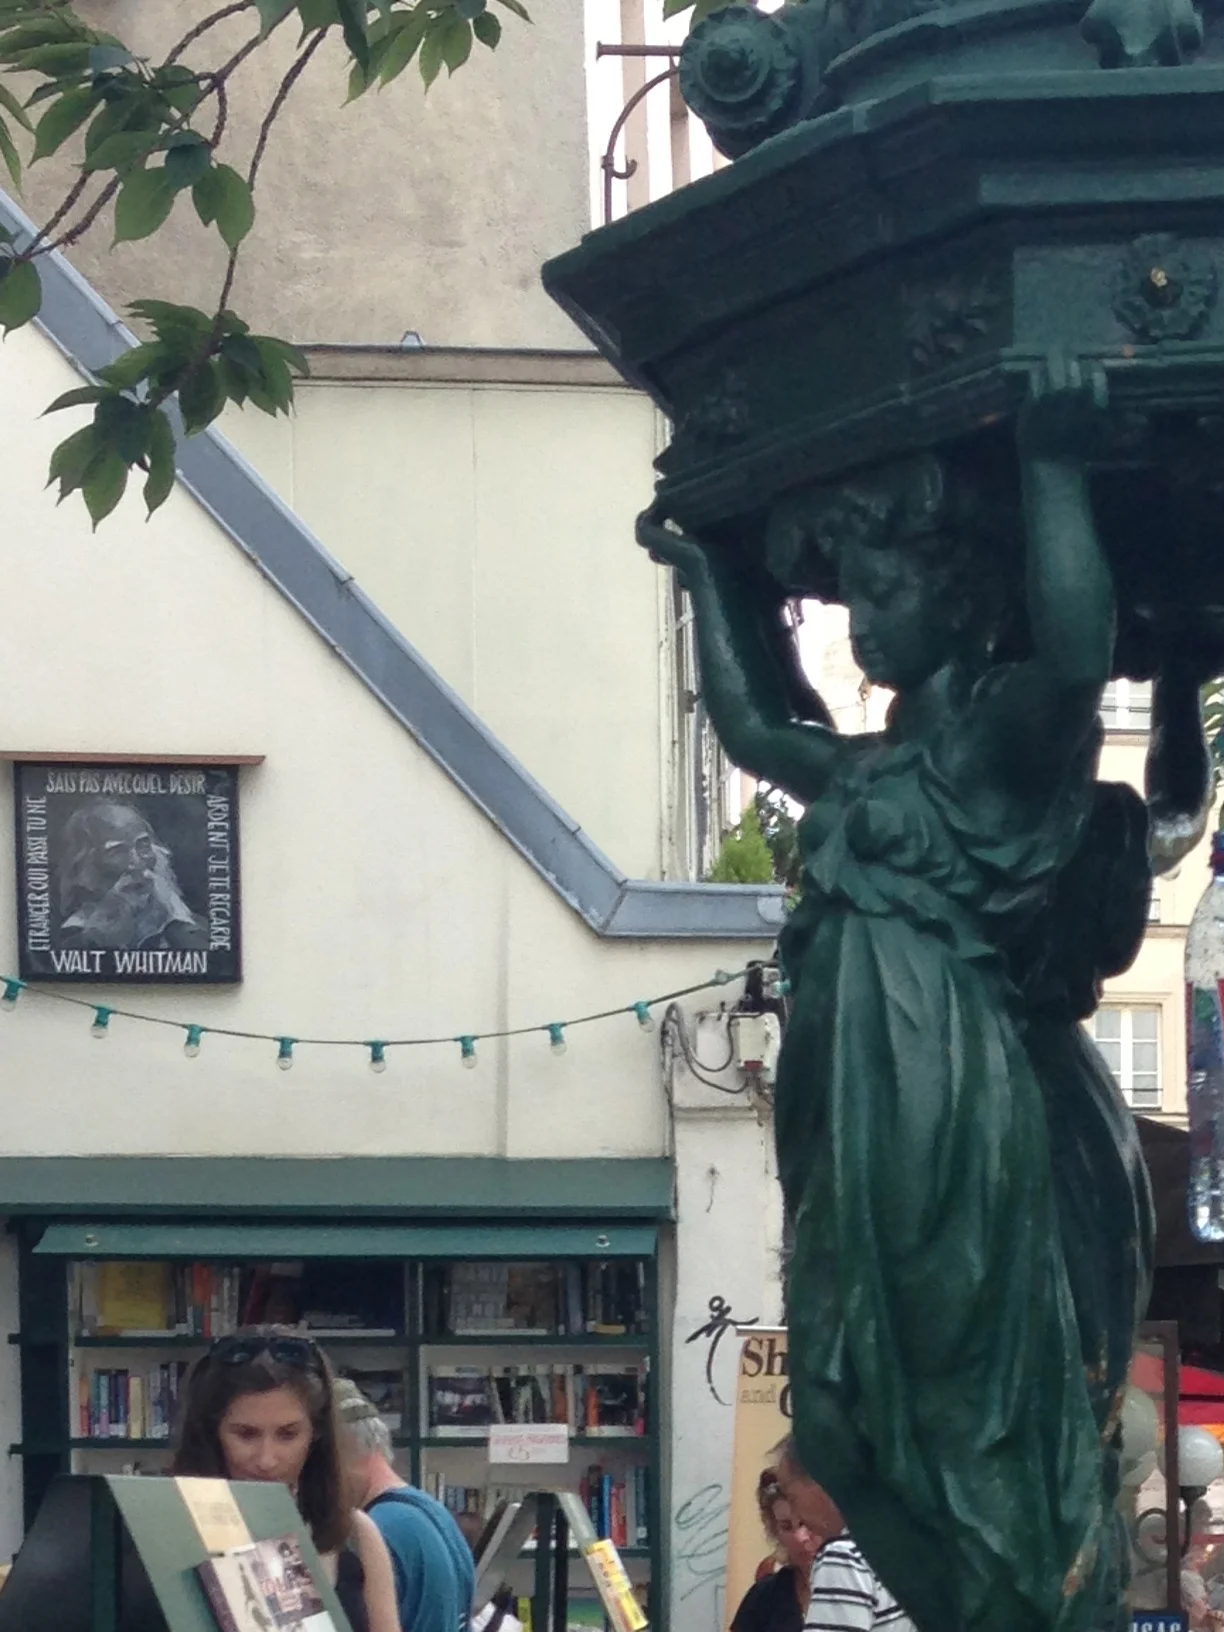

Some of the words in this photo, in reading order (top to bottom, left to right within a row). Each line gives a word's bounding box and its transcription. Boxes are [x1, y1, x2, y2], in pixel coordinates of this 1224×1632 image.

[46, 771, 76, 793] SAIS
[79, 771, 100, 793] PAS
[102, 772, 132, 794] AVEC
[132, 772, 166, 794] QUEL
[27, 816, 48, 833] TU
[206, 794, 231, 852] ARDENT
[208, 854, 231, 873] JE
[27, 868, 49, 891] QUI
[209, 875, 231, 891] TE
[208, 892, 232, 951] REGARDE
[50, 950, 106, 974] WALT
[114, 950, 208, 974] WHITMAN
